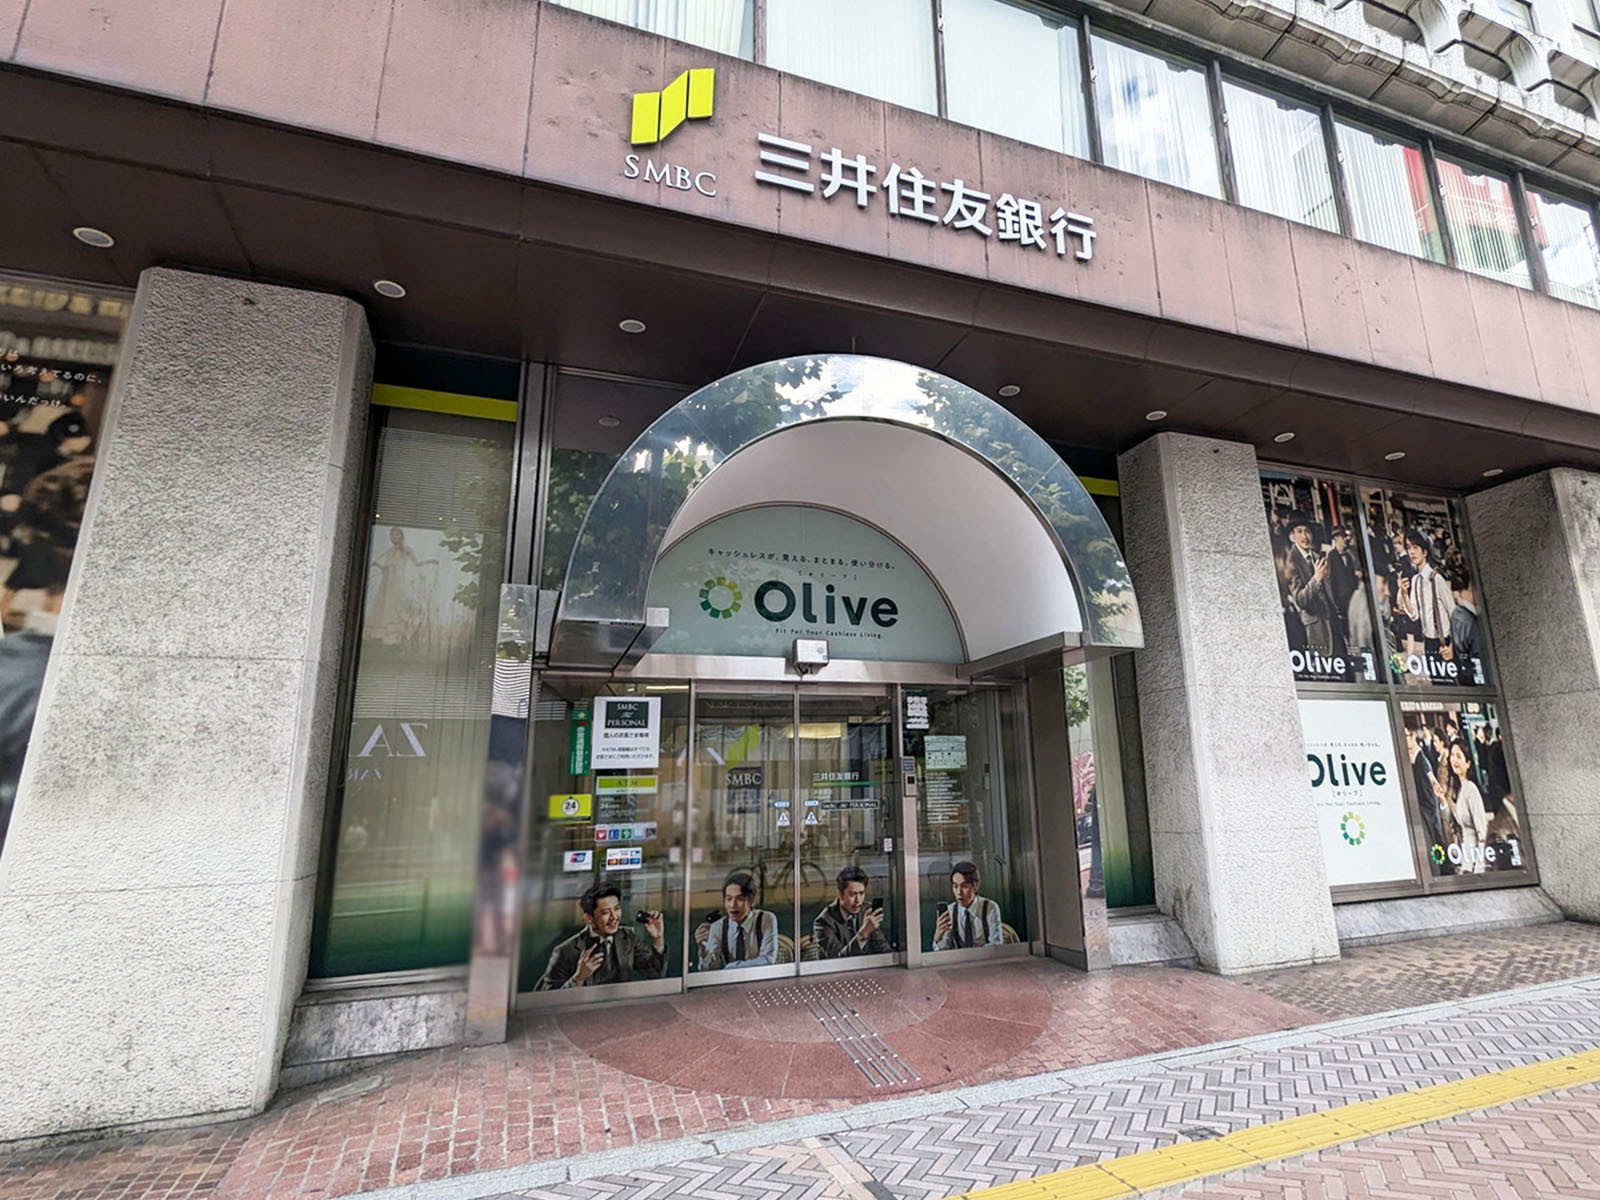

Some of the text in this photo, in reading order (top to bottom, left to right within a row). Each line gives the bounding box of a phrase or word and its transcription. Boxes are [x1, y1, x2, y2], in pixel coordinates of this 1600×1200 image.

[623, 153, 717, 197] SMBC
[755, 133, 1097, 261] 三井住友銀行
[0, 393, 67, 408] いんだっけ。
[754, 580, 898, 627] Olive
[806, 629, 823, 637] Your
[826, 630, 857, 638] Cashless
[1288, 649, 1346, 674] Olive
[1406, 655, 1458, 678] Olive
[617, 703, 639, 711] SMBC
[607, 719, 646, 727] PERSONAL
[725, 772, 762, 785] SMBC
[813, 771, 860, 781] 三井住友銀行
[564, 801, 577, 810] 24
[1447, 842, 1496, 865] Olive
